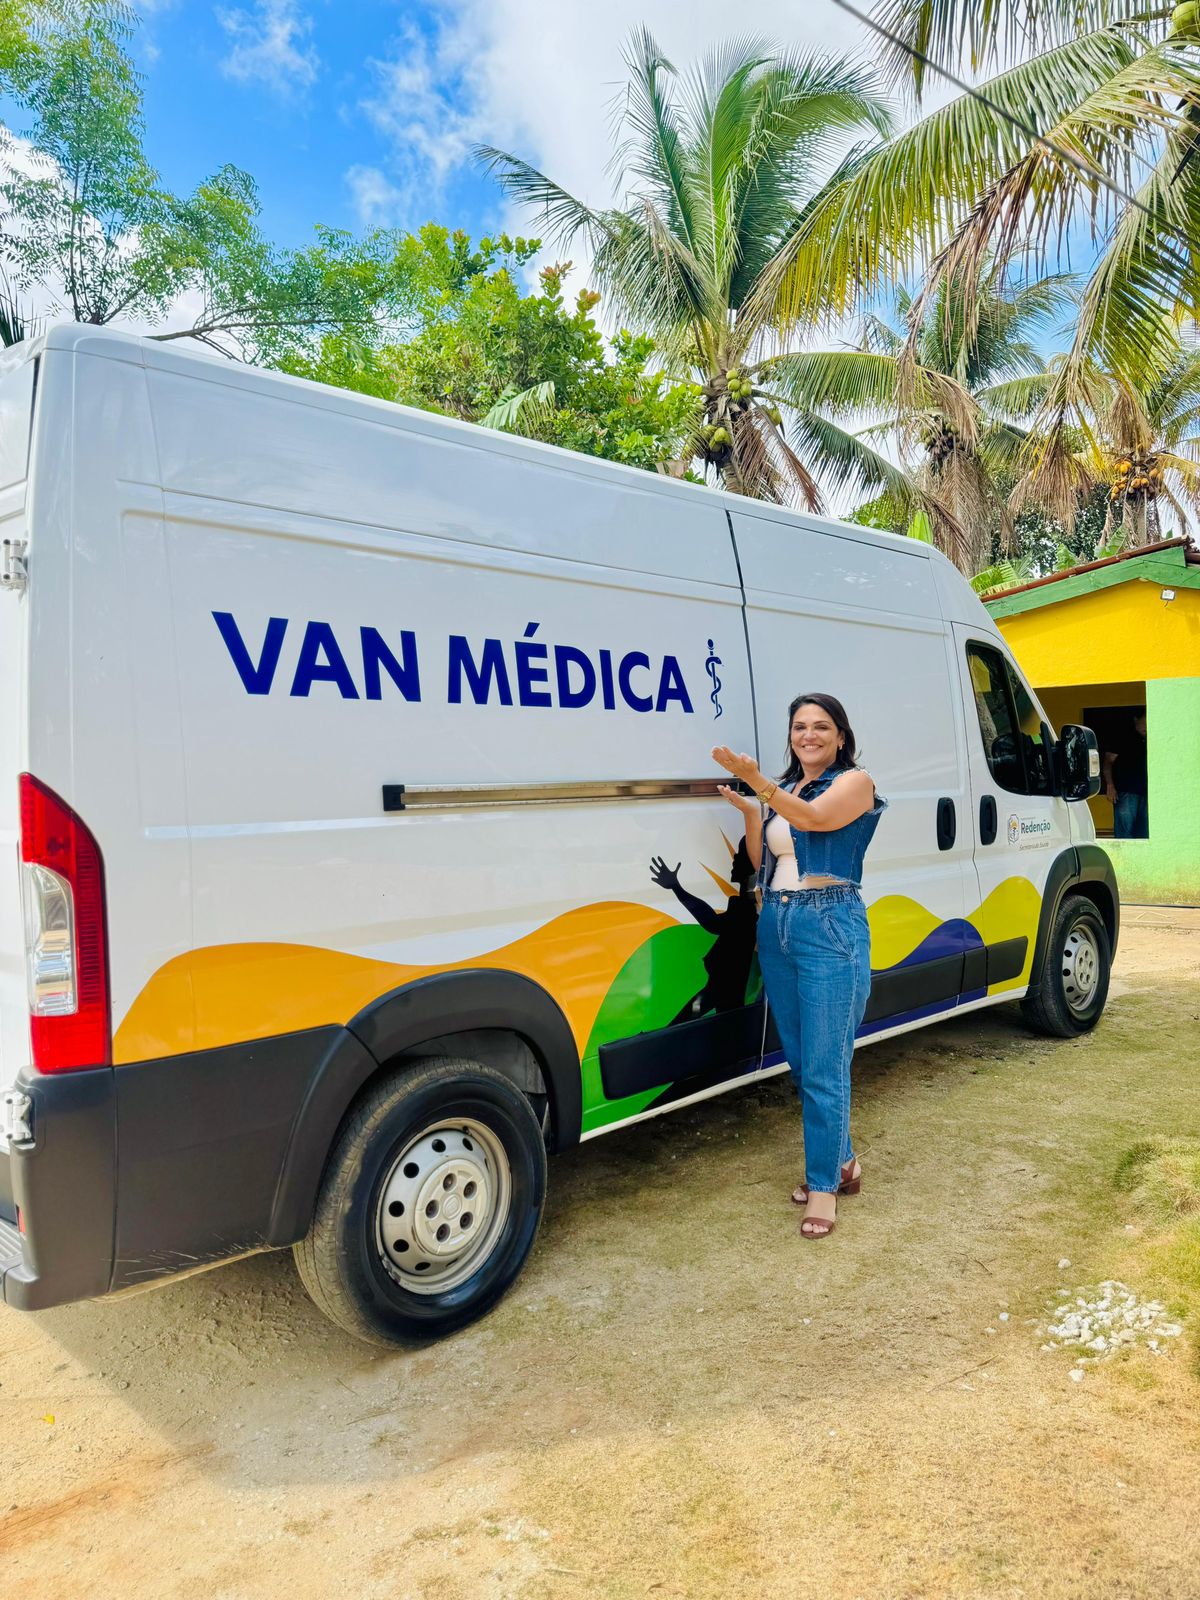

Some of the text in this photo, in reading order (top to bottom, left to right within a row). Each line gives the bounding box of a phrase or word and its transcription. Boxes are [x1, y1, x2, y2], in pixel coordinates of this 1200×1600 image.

[211, 611, 694, 713] VAN MÉDICA
[1021, 819, 1051, 835] Redenção
